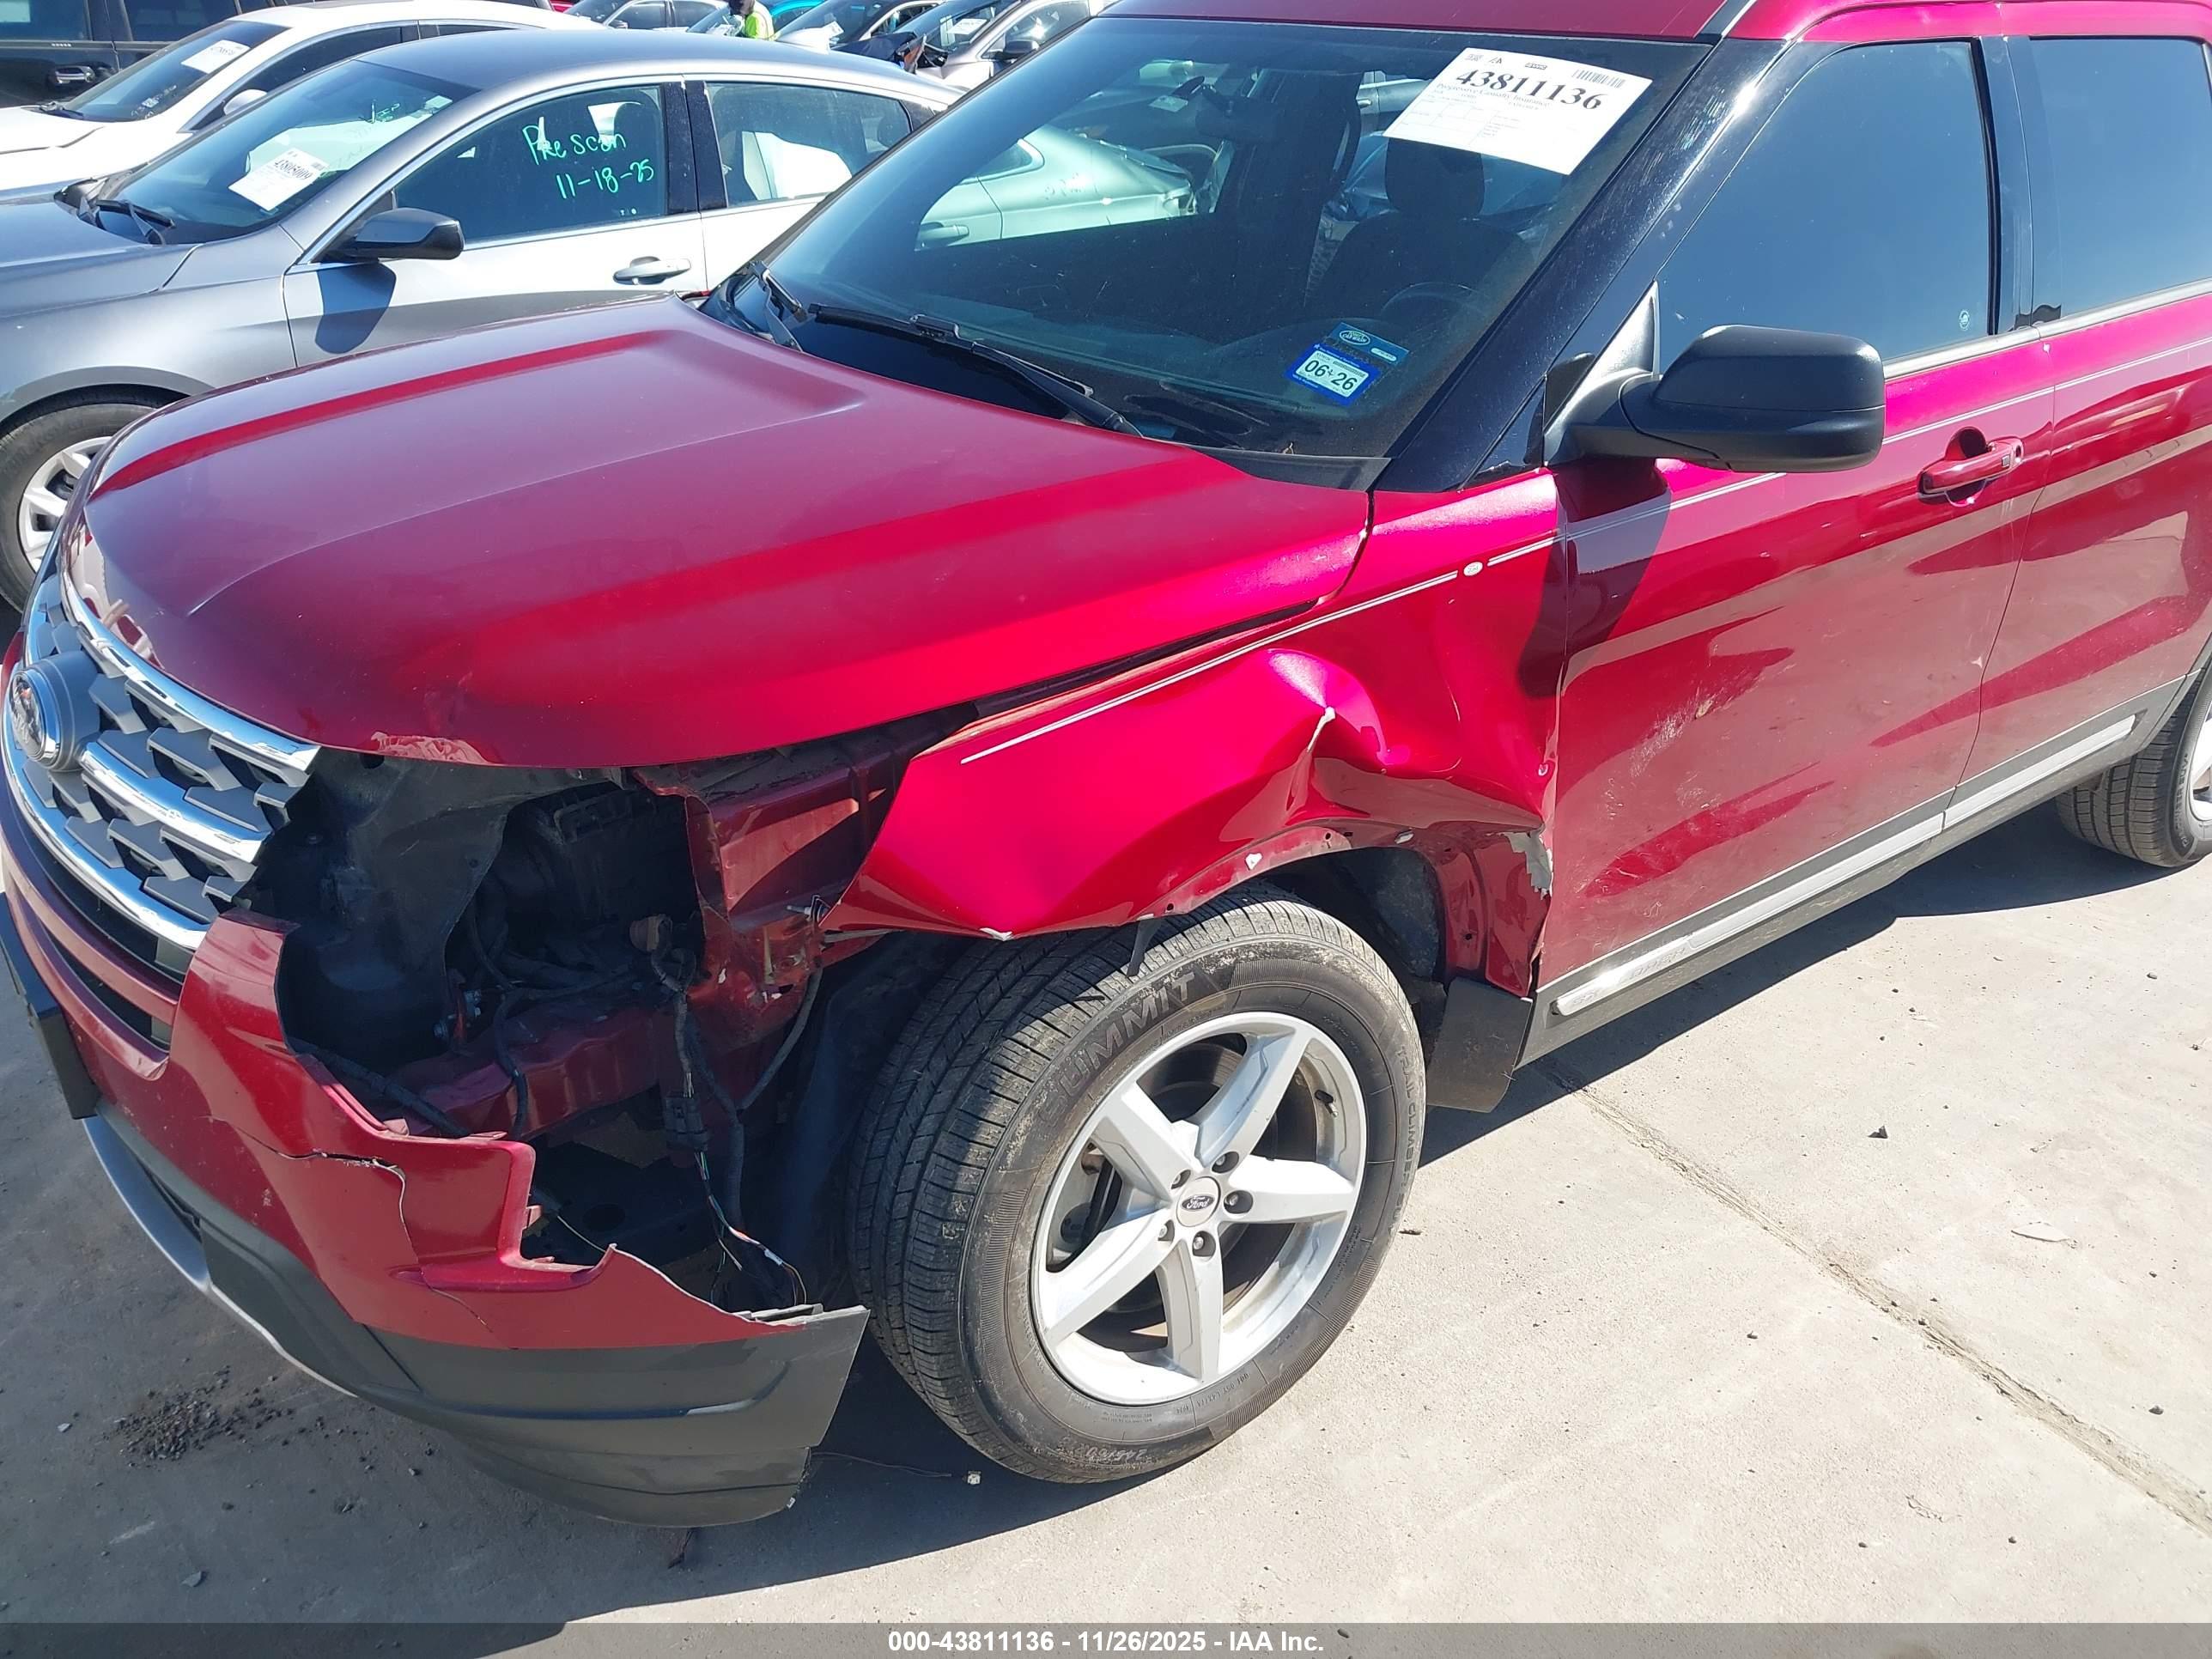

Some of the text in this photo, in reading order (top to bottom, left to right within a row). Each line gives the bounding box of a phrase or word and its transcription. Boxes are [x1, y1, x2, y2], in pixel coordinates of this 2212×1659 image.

[1456, 70, 1607, 109] 43811136
[556, 159, 653, 198] 11-18-25
[1036, 971, 1195, 1128] SUMMIT
[1395, 1045, 1414, 1099] TRAIL
[1401, 1103, 1416, 1187] CLIMBER
[1186, 1195, 1210, 1209] Ford
